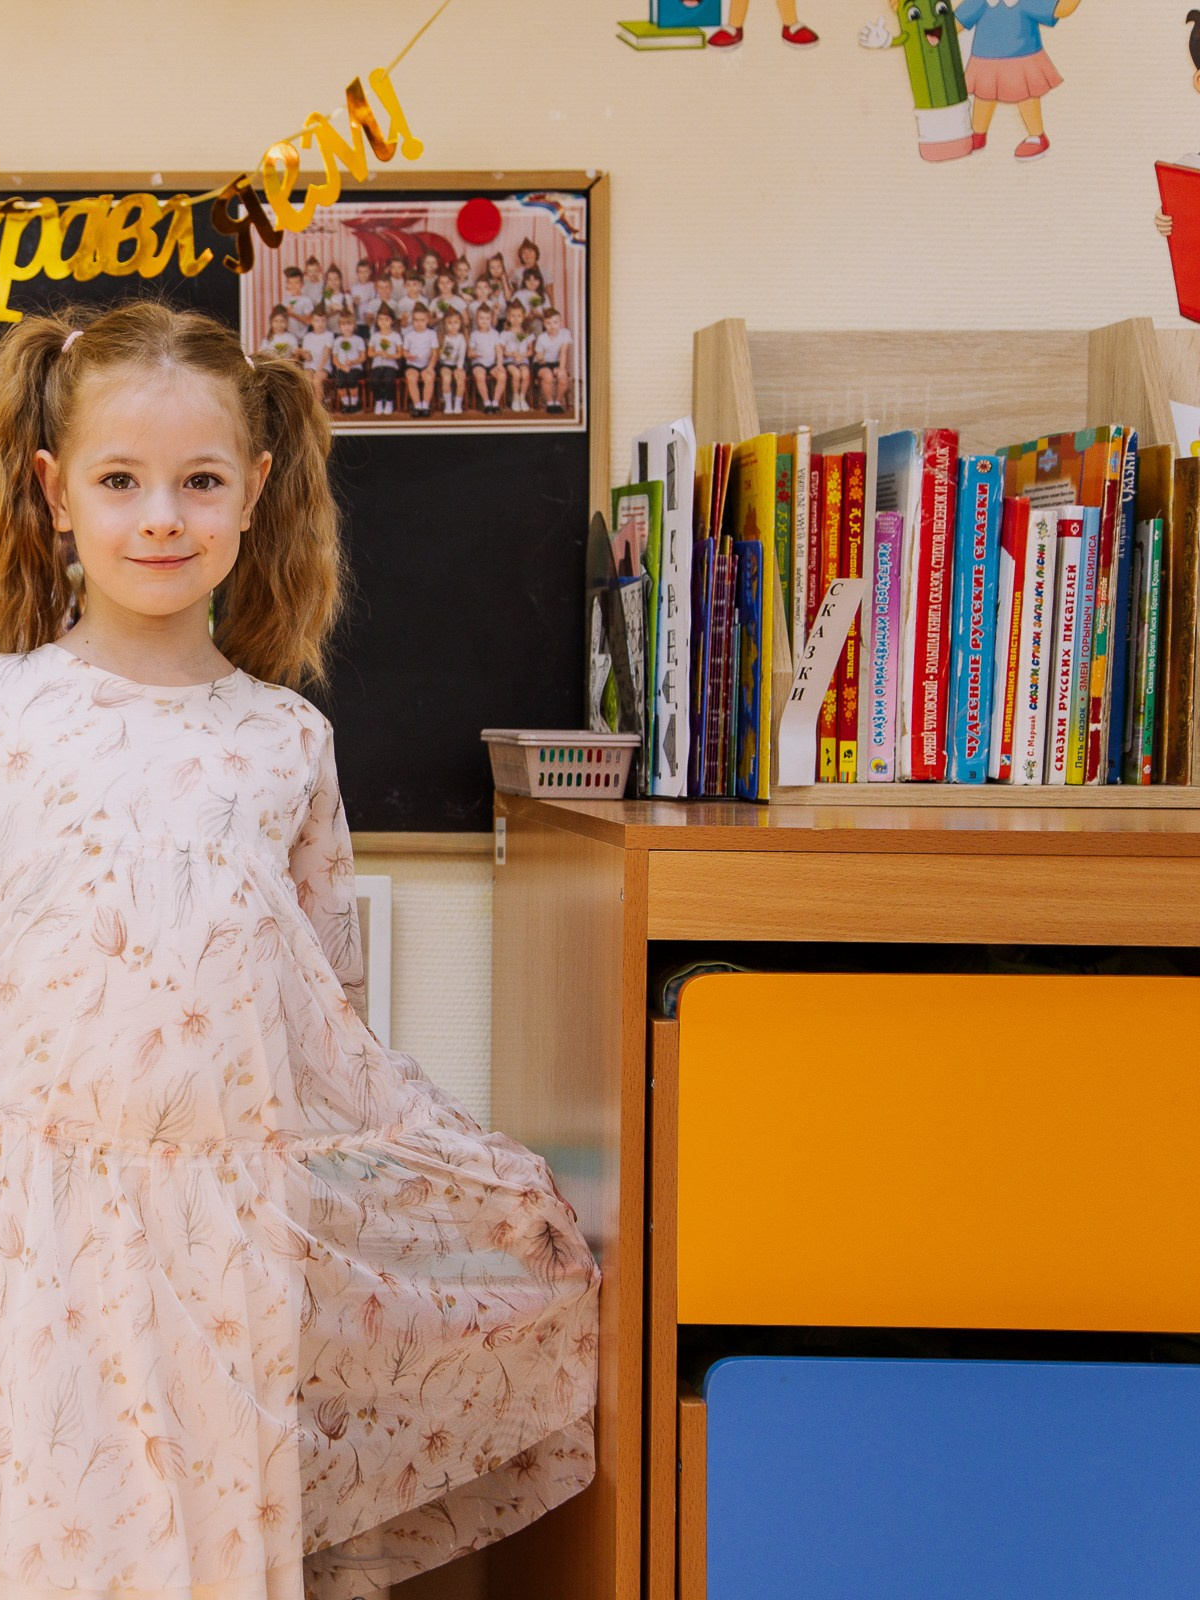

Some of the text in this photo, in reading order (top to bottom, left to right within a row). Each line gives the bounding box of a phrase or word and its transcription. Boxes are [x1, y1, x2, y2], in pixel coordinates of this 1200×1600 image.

[790, 582, 844, 701] СКАЗКИ
[928, 604, 942, 633] КНИГА
[965, 482, 990, 759] ЧУДЕСНЫЕ РУССКИЕ СКАЗКИ
[925, 633, 941, 674] БОЛЬШАЯ
[1003, 591, 1022, 743] МУРАВЬИШКА-ХВАСТУНИШКА
[1075, 534, 1098, 769] Пять сказок ЗМЕЙ ГОРЫНЫЧ И ВАСИЛИСА
[922, 680, 939, 731] ЧУКОВСКИЙ
[1028, 714, 1038, 748] Маршак
[921, 731, 937, 766] КОРНЕЙ
